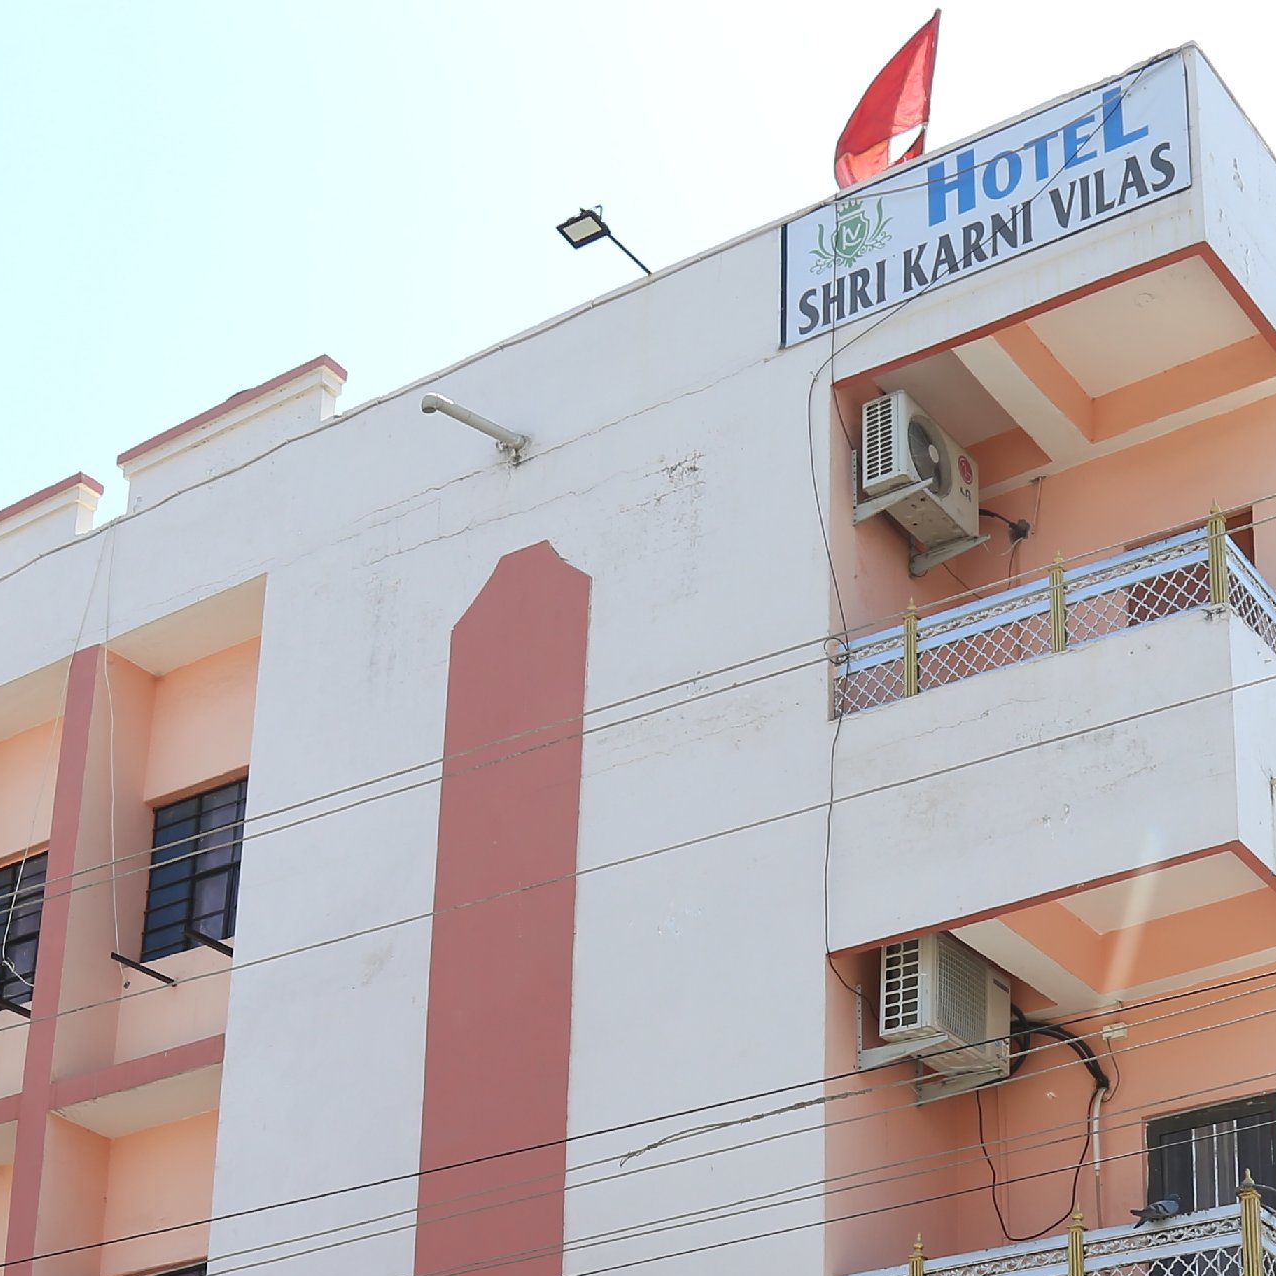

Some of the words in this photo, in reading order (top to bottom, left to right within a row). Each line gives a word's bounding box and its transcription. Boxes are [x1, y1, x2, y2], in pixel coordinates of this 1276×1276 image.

[798, 259, 886, 335] SHRI
[903, 200, 1033, 293] KARNI
[1049, 142, 1175, 228] VILAS
[928, 85, 1148, 227] HOTEL
